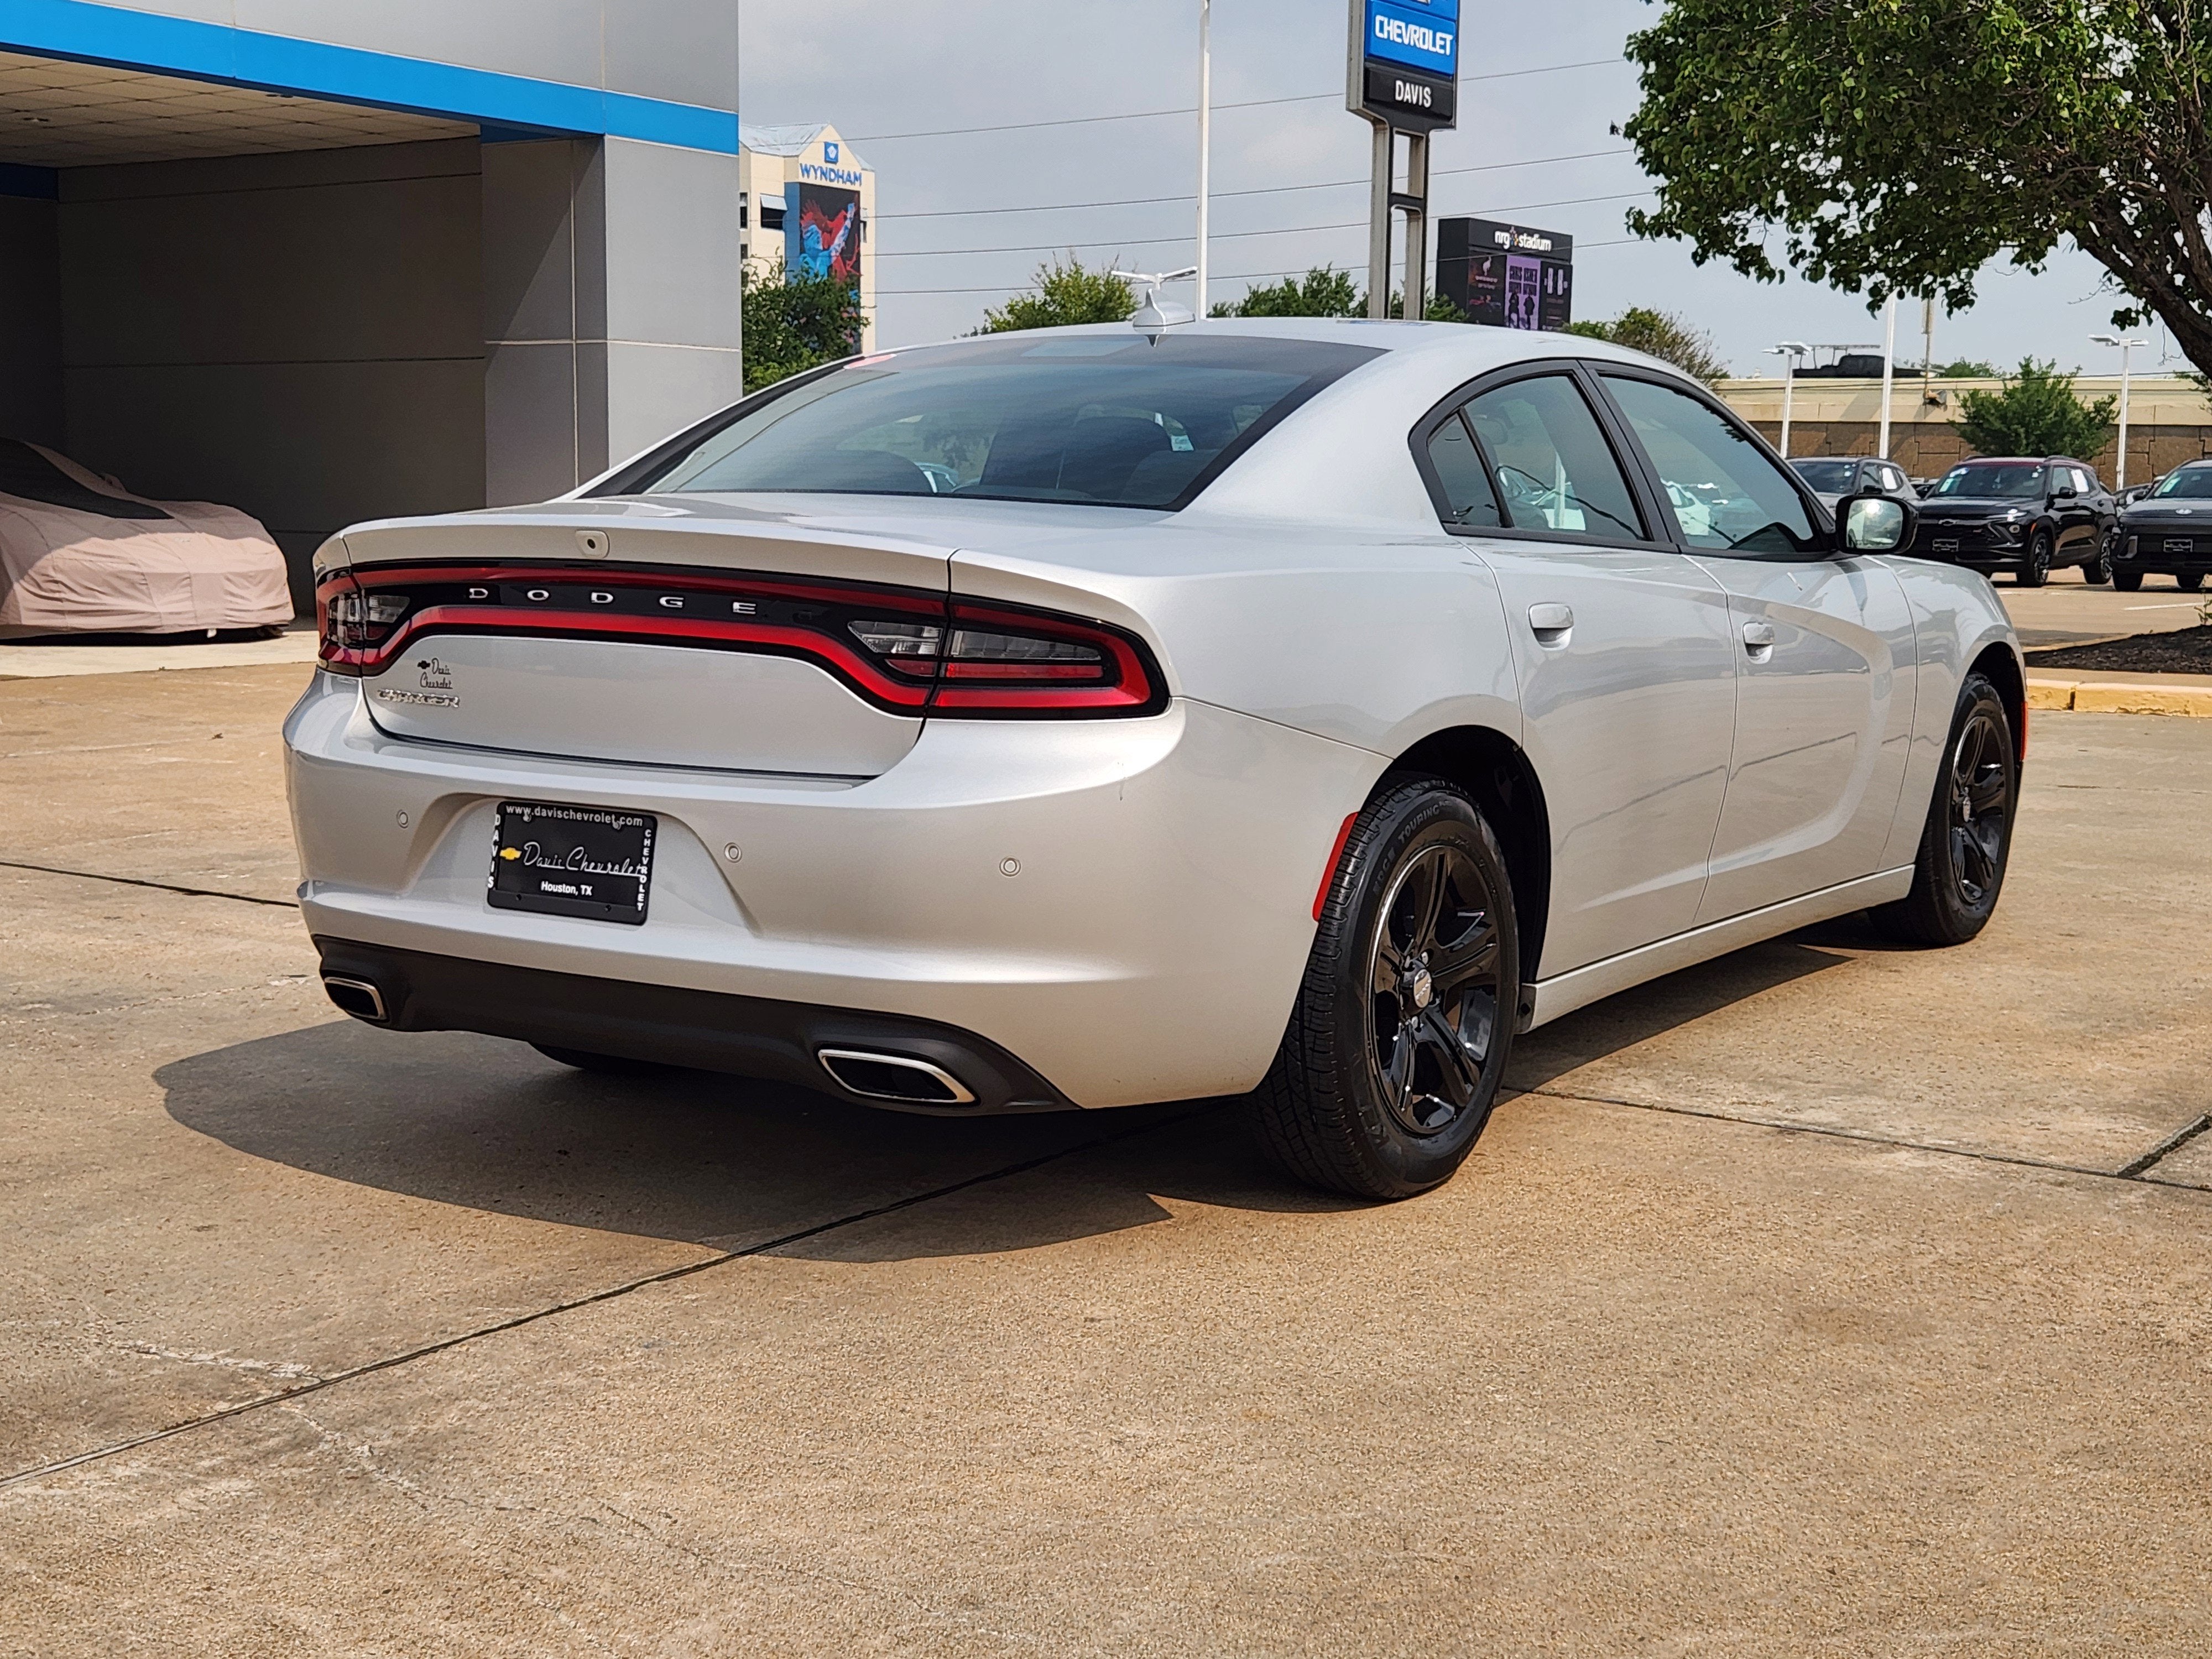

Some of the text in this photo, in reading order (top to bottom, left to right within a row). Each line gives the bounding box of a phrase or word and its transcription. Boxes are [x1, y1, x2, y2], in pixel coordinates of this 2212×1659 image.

[1375, 14, 1453, 56] CHEVROLET
[1395, 80, 1432, 108] DAVIS
[800, 163, 862, 186] WYNDHAM
[468, 587, 757, 614] DODGE
[377, 689, 460, 707] CHARGER
[505, 805, 643, 827] www.davischevrolet.com
[1397, 804, 1440, 844] TOURING
[524, 841, 565, 869] Davis
[566, 847, 642, 878] Chevrolet
[540, 881, 593, 896] Houston, TX
